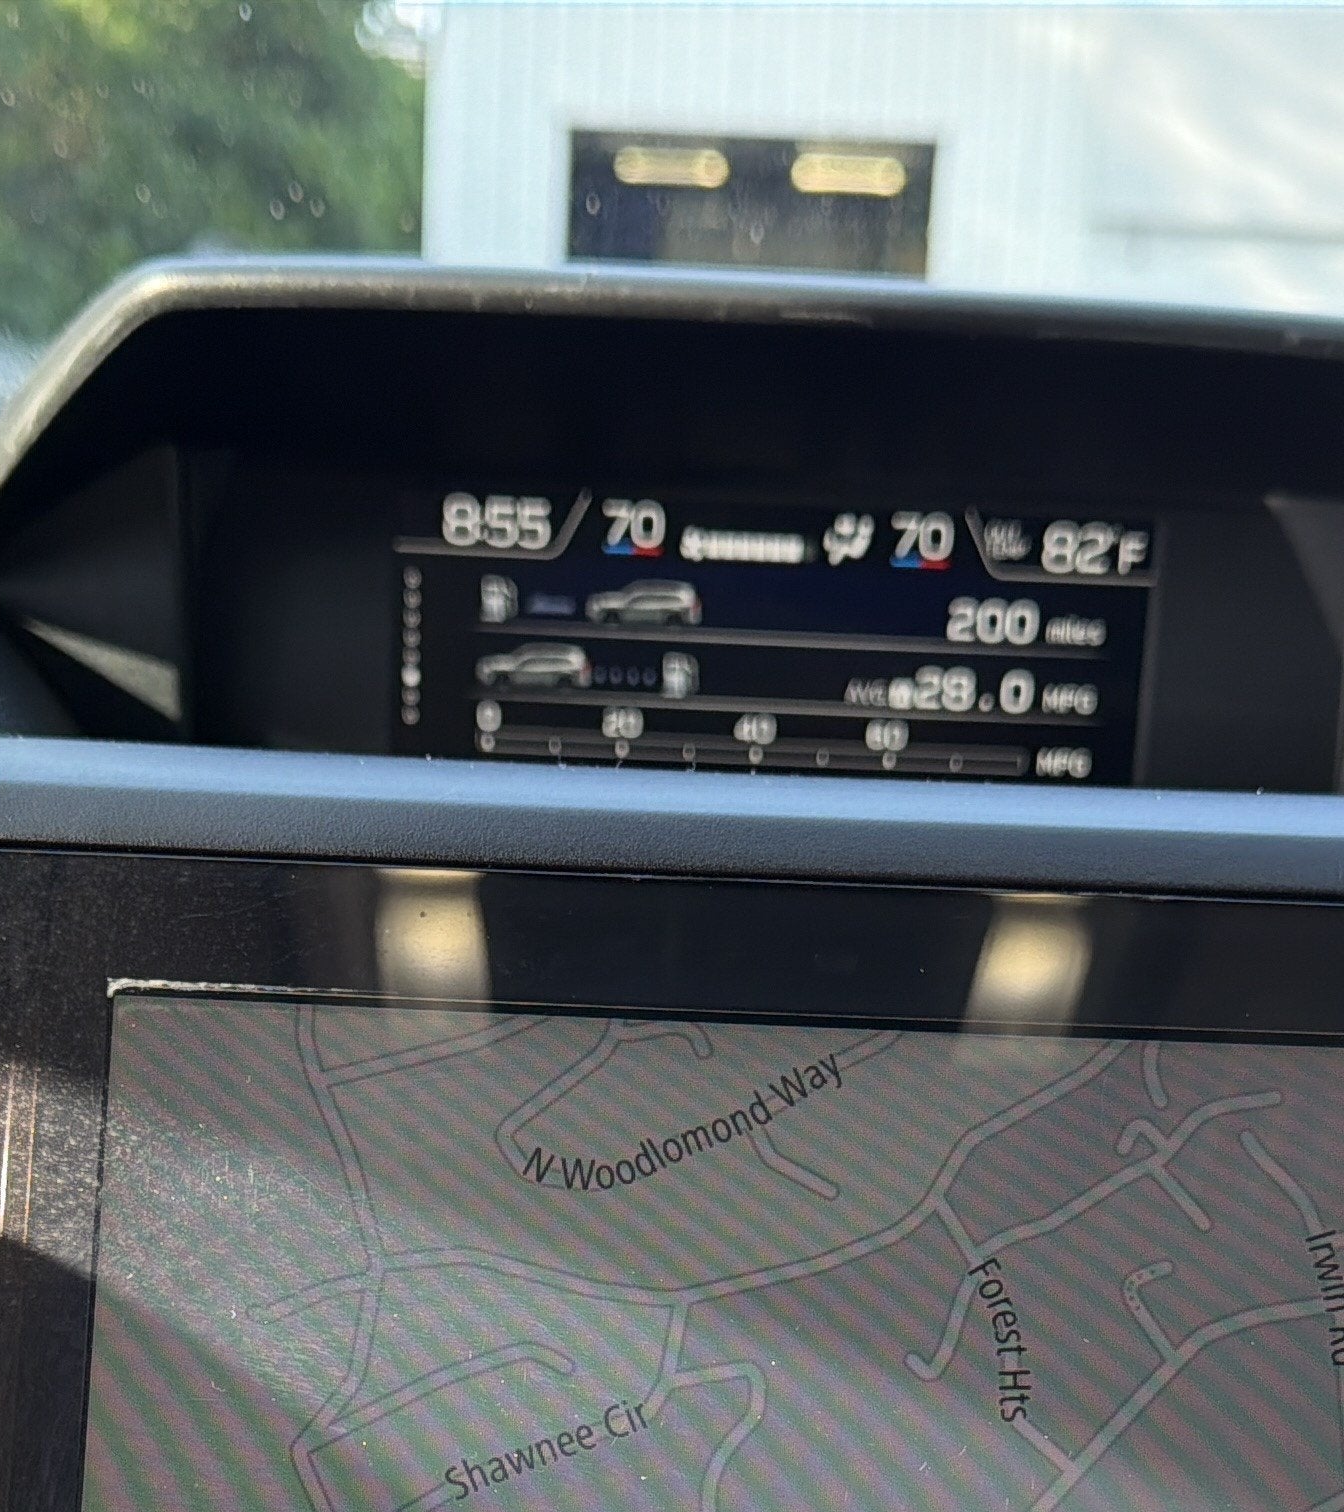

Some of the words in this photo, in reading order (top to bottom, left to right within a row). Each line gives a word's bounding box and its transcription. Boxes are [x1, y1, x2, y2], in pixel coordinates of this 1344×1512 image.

[602, 499, 666, 548] 70
[891, 511, 955, 561] 70
[947, 597, 1040, 645] 200
[524, 1146, 557, 1180] N
[561, 1091, 773, 1191] Woodlomond
[770, 1050, 844, 1114] Way
[969, 1257, 1032, 1365] Forest
[998, 1367, 1033, 1423] Hts
[444, 1425, 596, 1502] Shawnee
[603, 1399, 652, 1438] Cir
